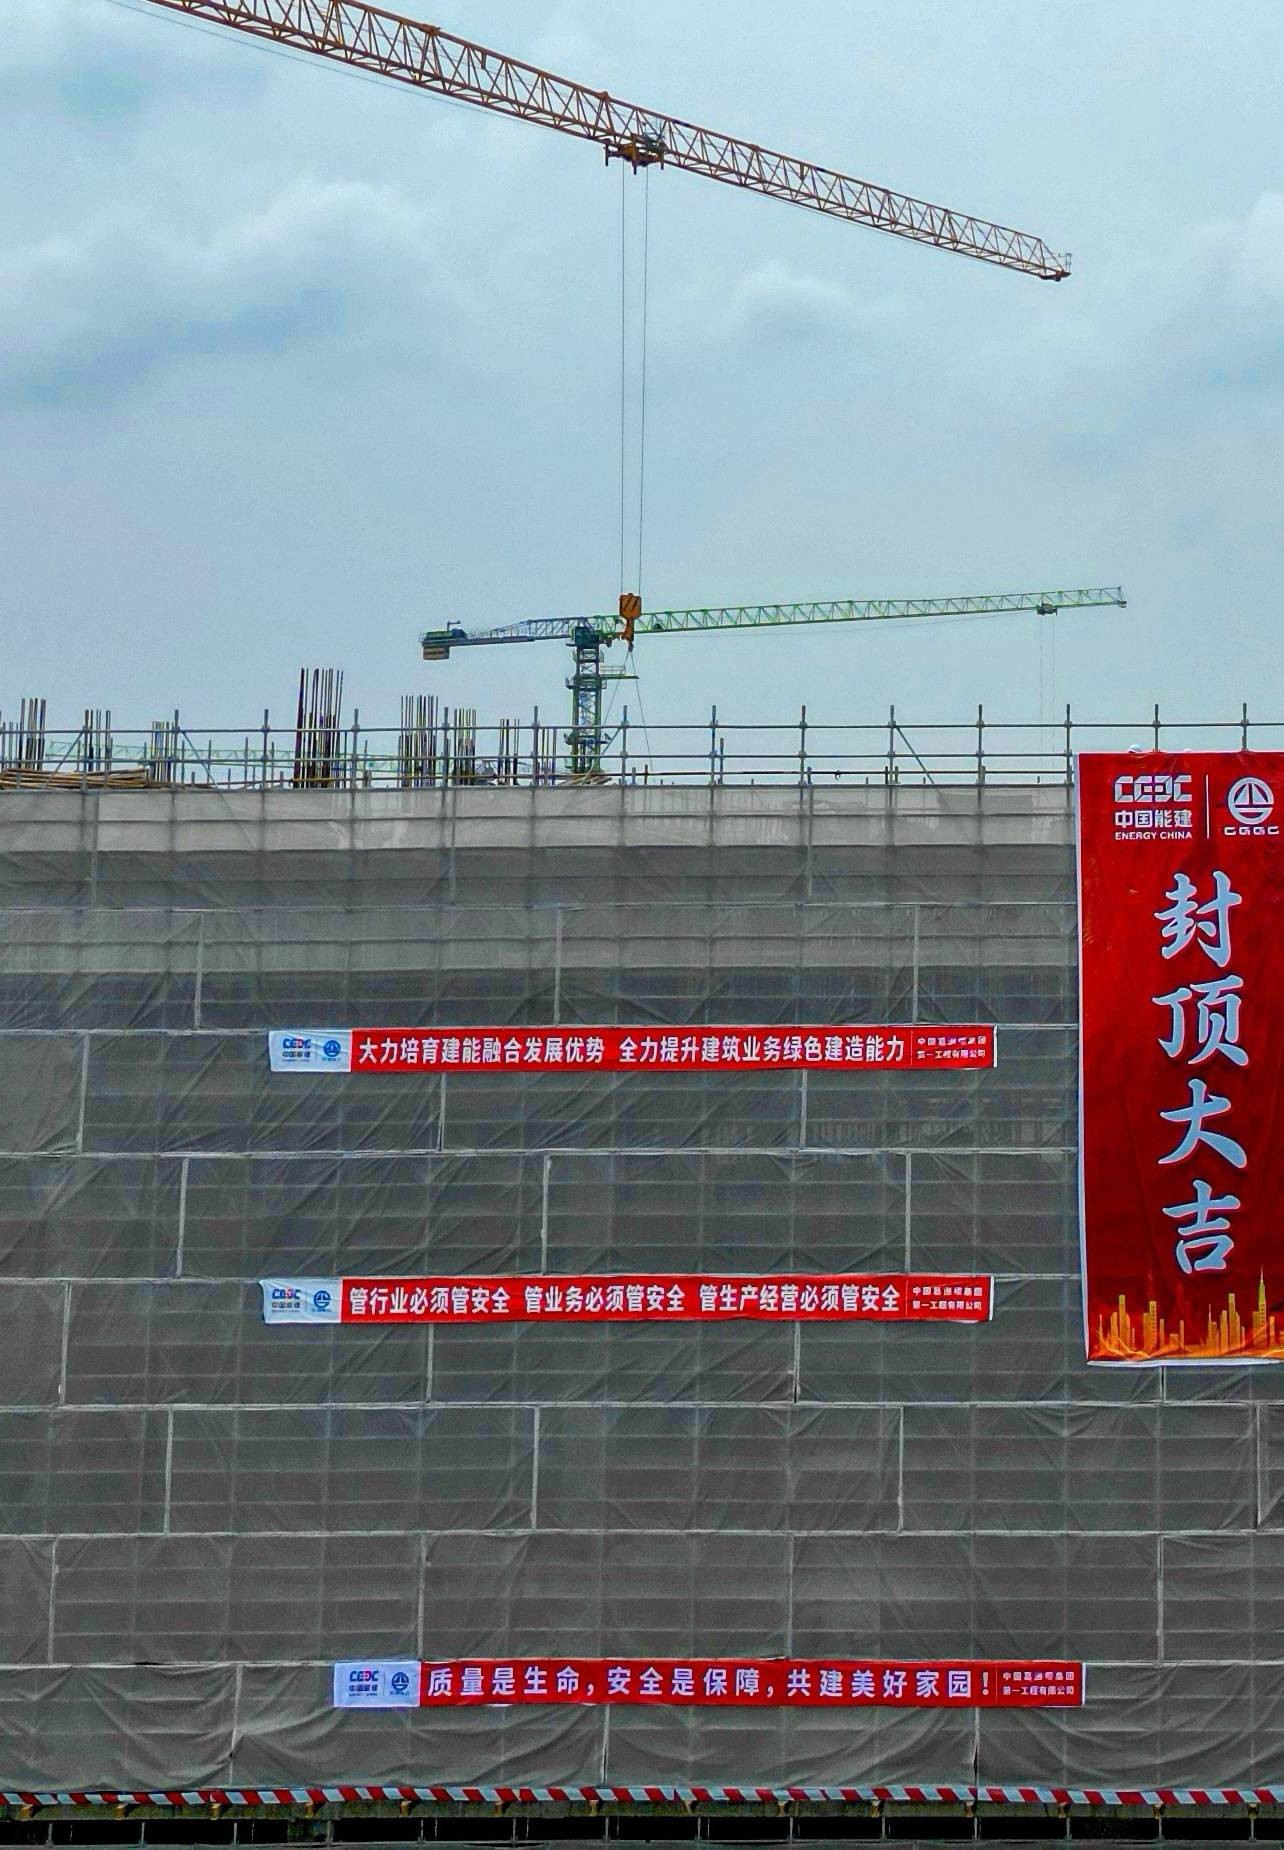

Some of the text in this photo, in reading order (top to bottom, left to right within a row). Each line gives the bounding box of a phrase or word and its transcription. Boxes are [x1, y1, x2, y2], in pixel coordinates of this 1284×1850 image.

[1115, 810, 1192, 828] 中国能建
[1115, 832, 1192, 840] ENERGY CHINA
[360, 1035, 904, 1063] 大力培育建能融合发展优势 全力提升建筑业务绿色建造能力
[1152, 870, 1249, 1275] 封顶大吉
[350, 1284, 899, 1314] 管行业必须管安全 管业务必须管安全 管生产经营必须管安全
